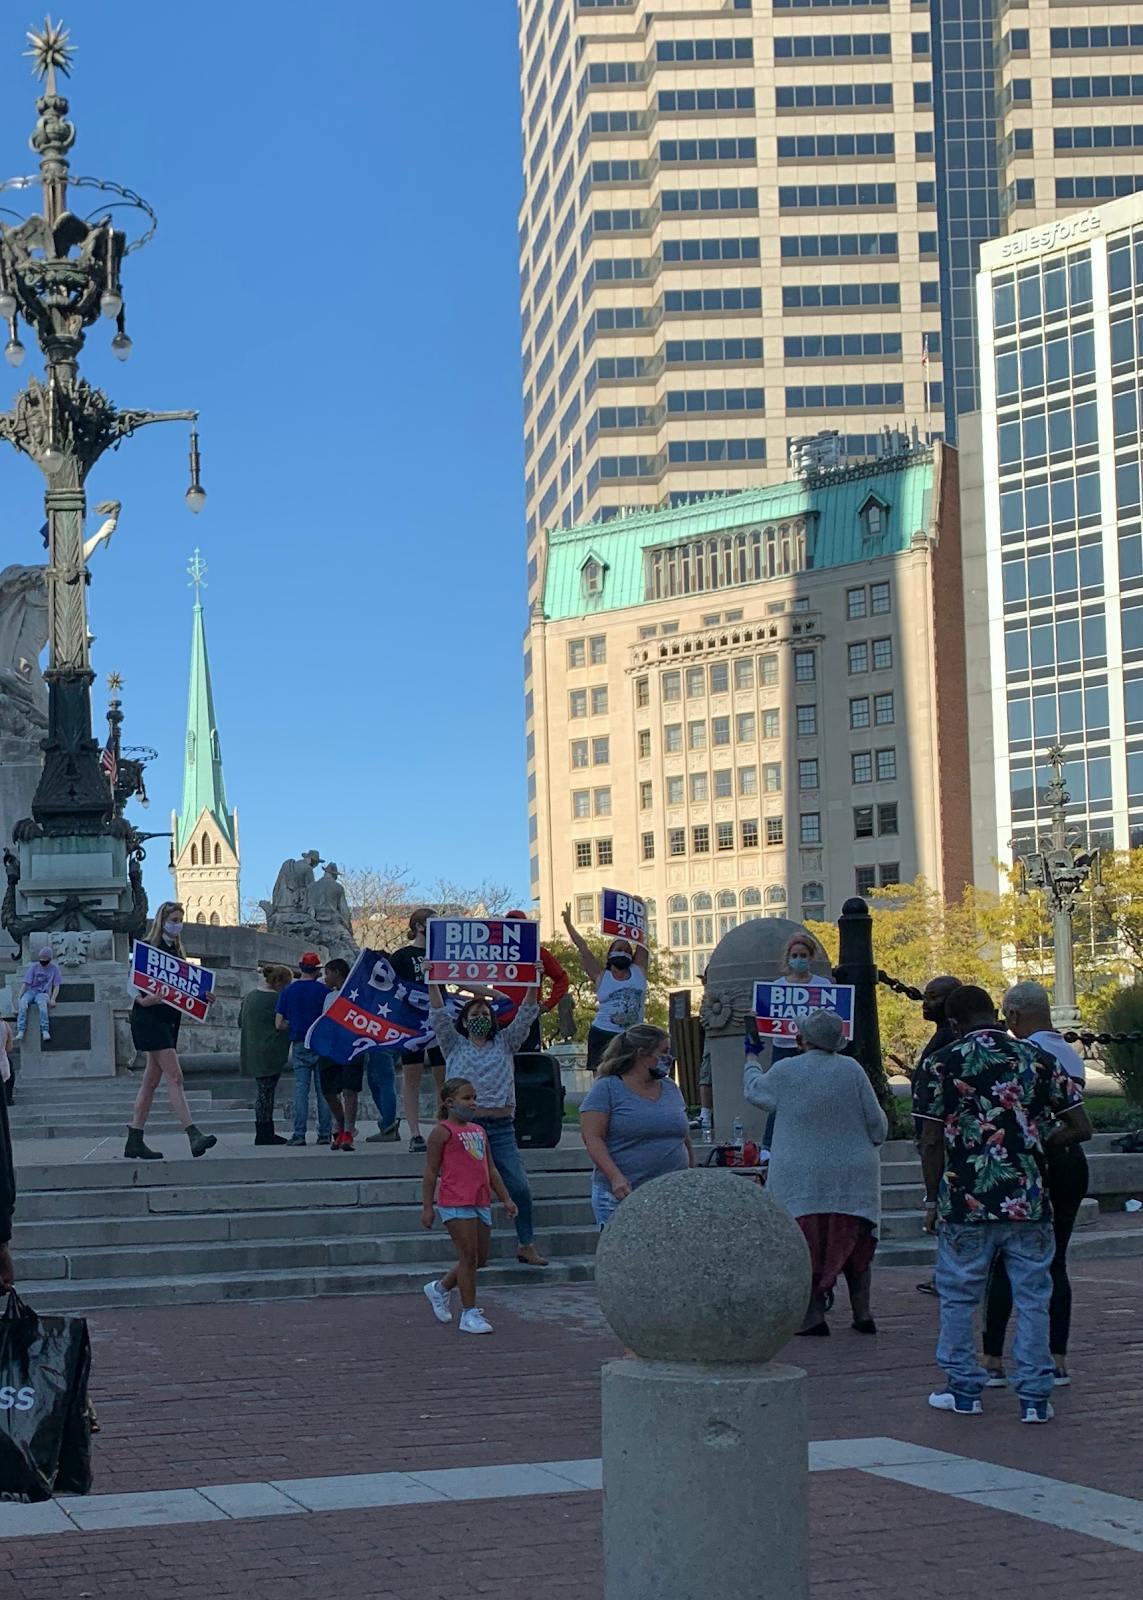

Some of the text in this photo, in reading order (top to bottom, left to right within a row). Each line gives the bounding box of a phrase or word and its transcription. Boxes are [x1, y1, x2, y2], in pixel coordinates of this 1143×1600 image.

[1001, 216, 1101, 258] salesforce
[445, 922, 521, 944] BIDEN
[147, 949, 202, 984] BIDEN
[445, 944, 521, 961] HARRIS
[146, 963, 200, 997] HARRIS
[448, 963, 518, 979] 2020
[147, 979, 195, 1010] 2020
[770, 986, 837, 1005] BIDEN
[344, 1008, 382, 1036] FOR
